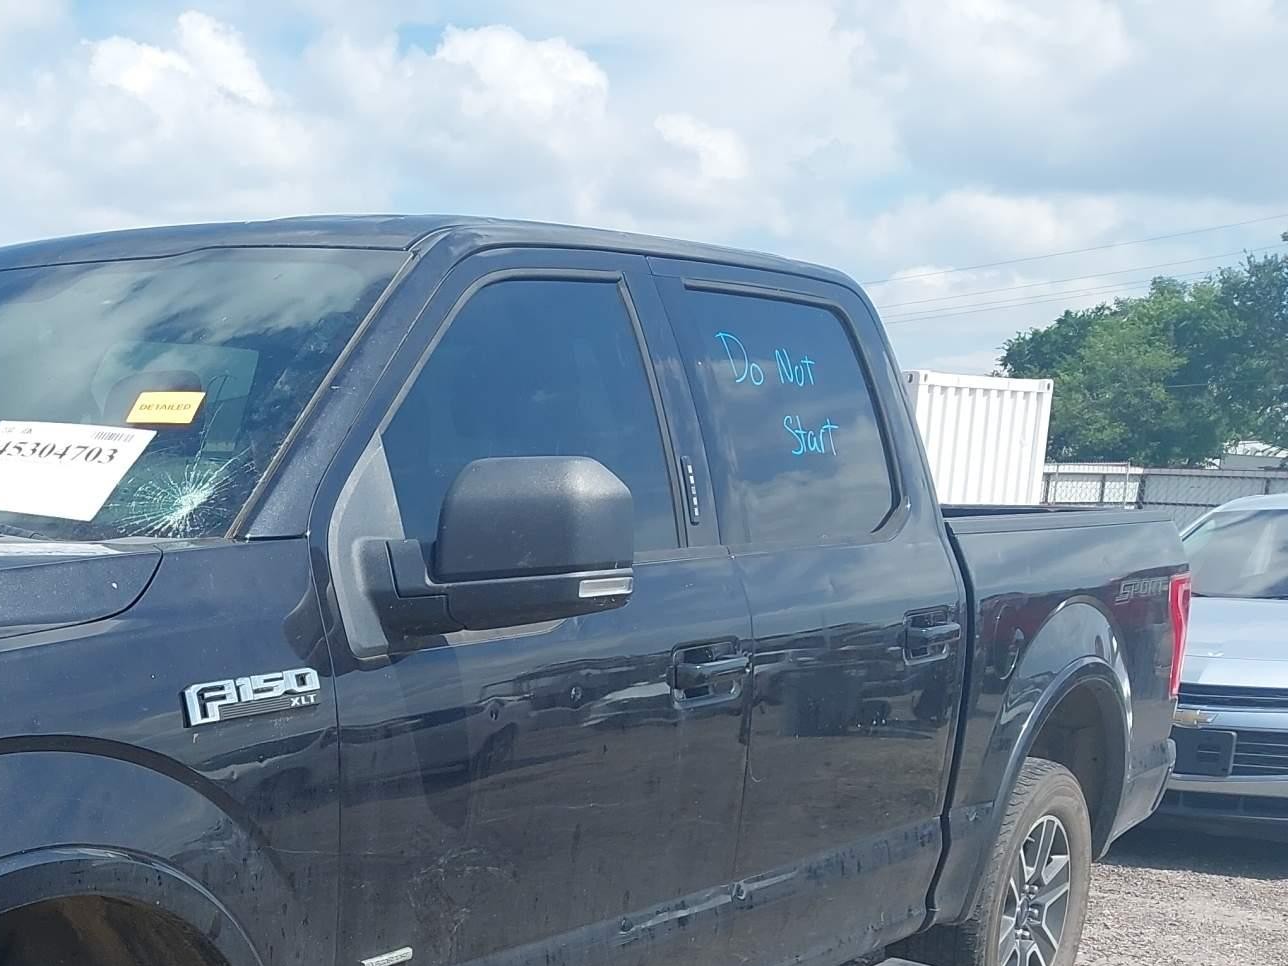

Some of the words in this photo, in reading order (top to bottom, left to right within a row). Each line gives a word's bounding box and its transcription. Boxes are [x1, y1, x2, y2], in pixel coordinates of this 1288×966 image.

[715, 332, 763, 385] Do
[775, 348, 815, 386] Not
[139, 403, 191, 411] DETAILED
[783, 415, 839, 456] Start
[290, 693, 317, 707] XLT
